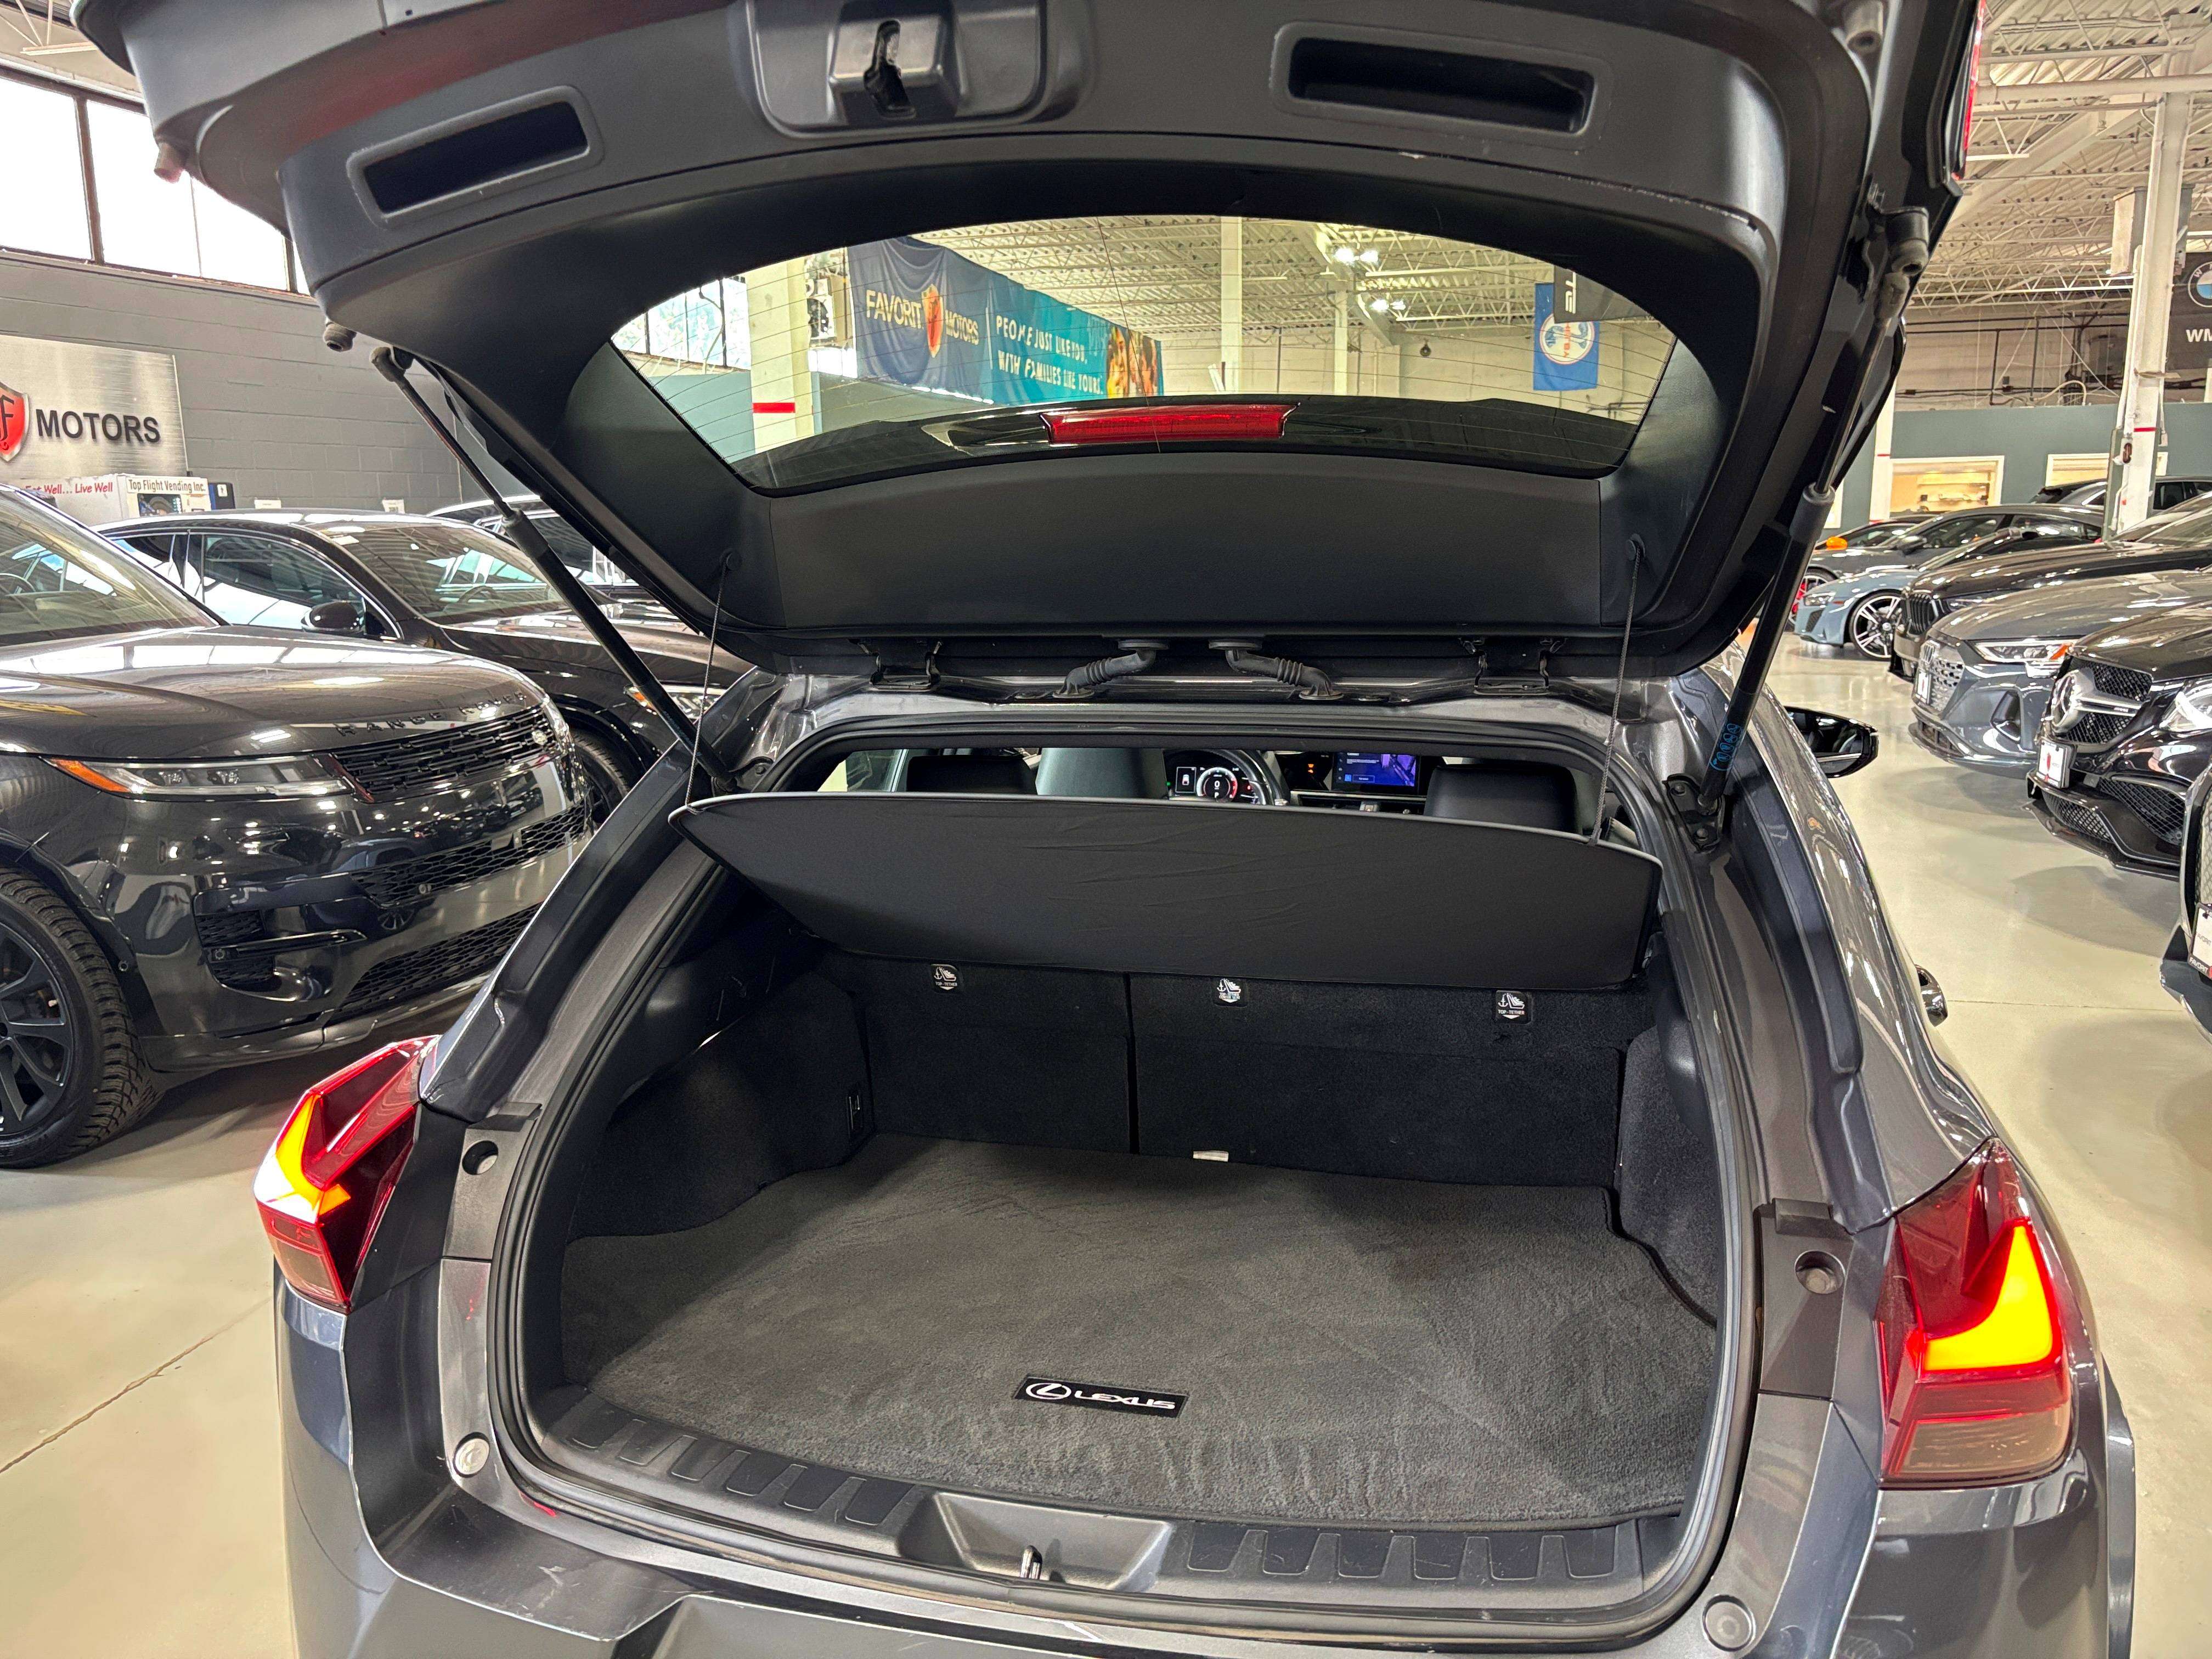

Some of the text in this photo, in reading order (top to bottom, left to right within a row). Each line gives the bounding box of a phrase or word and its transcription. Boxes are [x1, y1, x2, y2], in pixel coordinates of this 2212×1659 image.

[866, 290, 979, 345] FAVORIT MOTORS
[1034, 329, 1053, 352] JUST
[998, 349, 1021, 375] WITH
[1024, 358, 1061, 386] FAMILIES
[36, 409, 161, 443] MOTORS
[75, 482, 93, 494] Live
[94, 482, 113, 493] Well
[128, 479, 206, 493] Top Flight Vending Inc.
[332, 712, 442, 737] RANGE
[1074, 1390, 1176, 1410] LEXUS
